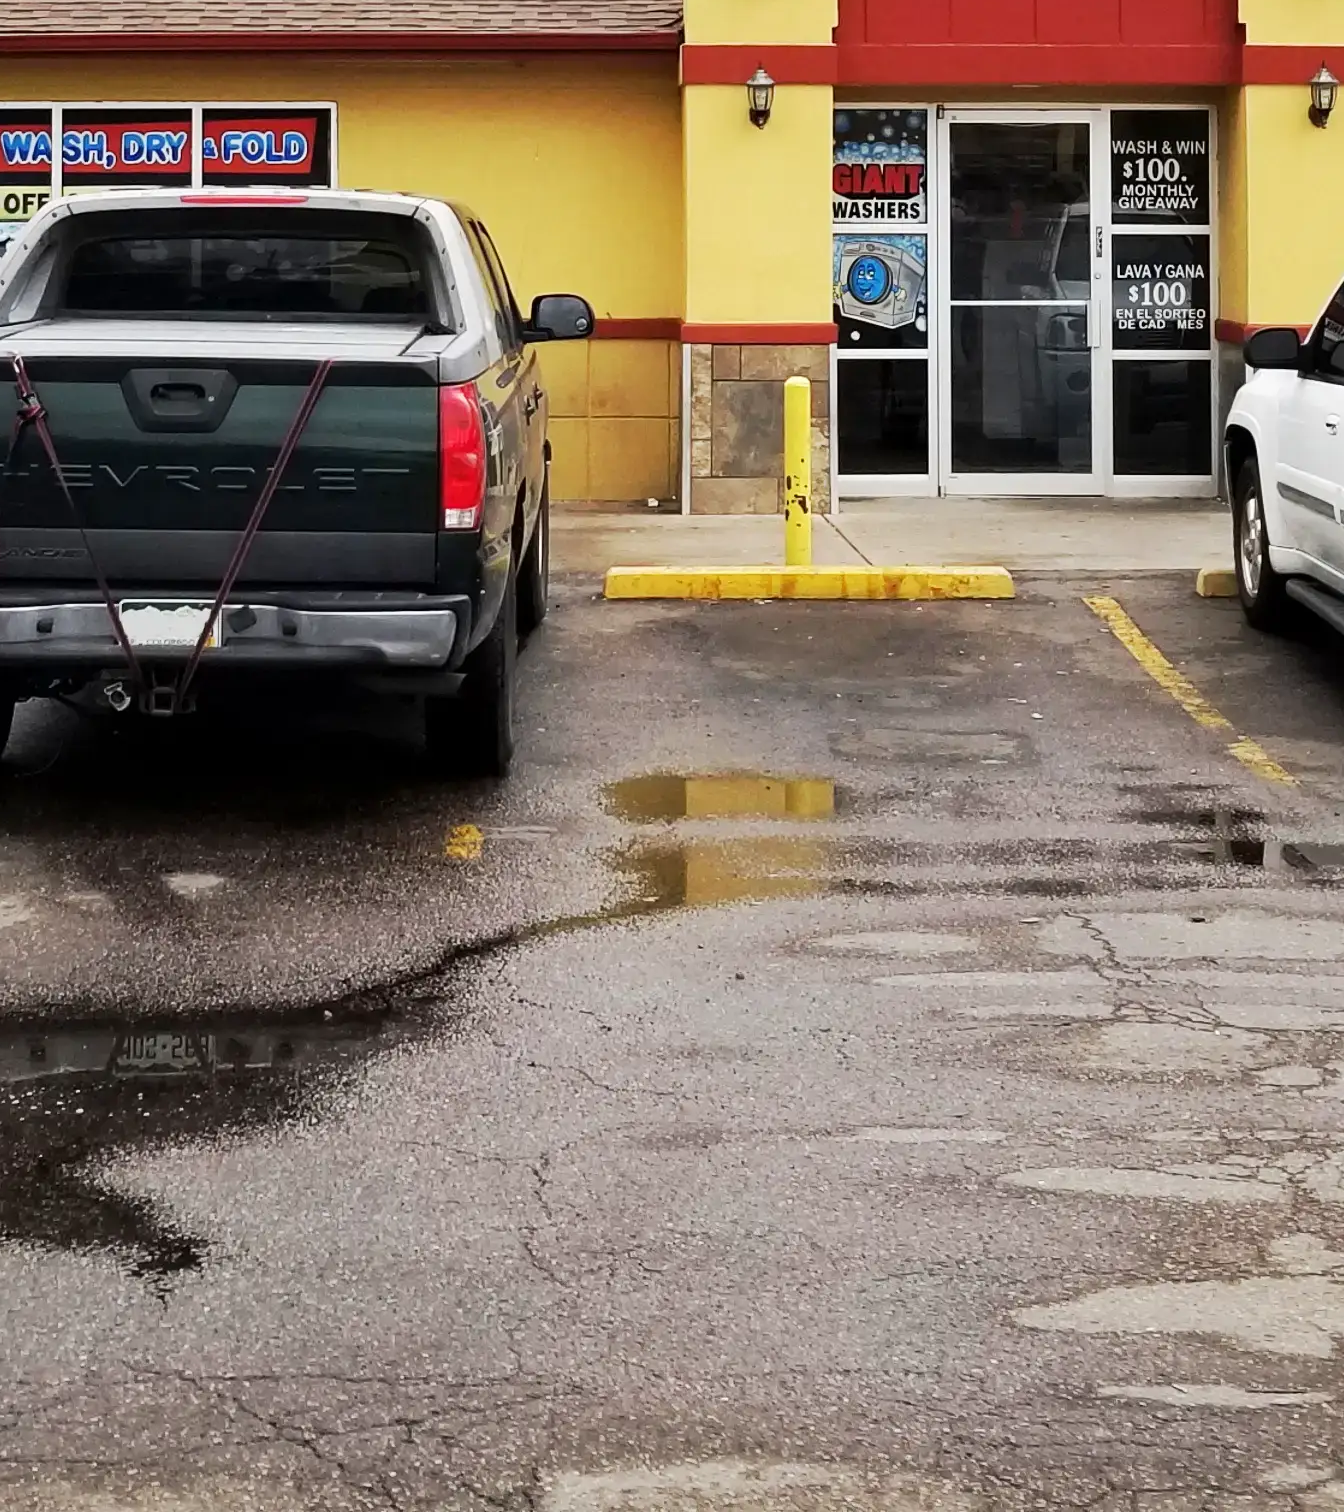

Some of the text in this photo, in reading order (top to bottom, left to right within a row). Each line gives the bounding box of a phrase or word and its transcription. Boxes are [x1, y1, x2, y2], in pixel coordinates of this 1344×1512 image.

[121, 130, 188, 165] DRY
[221, 130, 308, 165] FOLD
[1112, 140, 1205, 155] WASH & WIN
[1122, 157, 1188, 182] $100.
[833, 163, 923, 197] GIANT
[1122, 184, 1195, 197] MONTHLY
[3, 193, 50, 215] OFF
[833, 202, 921, 219] WASHERS
[1118, 196, 1199, 209] GIVEAWAY
[1117, 264, 1205, 279] LAVA Y GANA
[1128, 281, 1187, 306] $100
[1116, 308, 1207, 319] EN EL SORTEO
[1118, 319, 1136, 330] DE
[1177, 319, 1204, 330] MES
